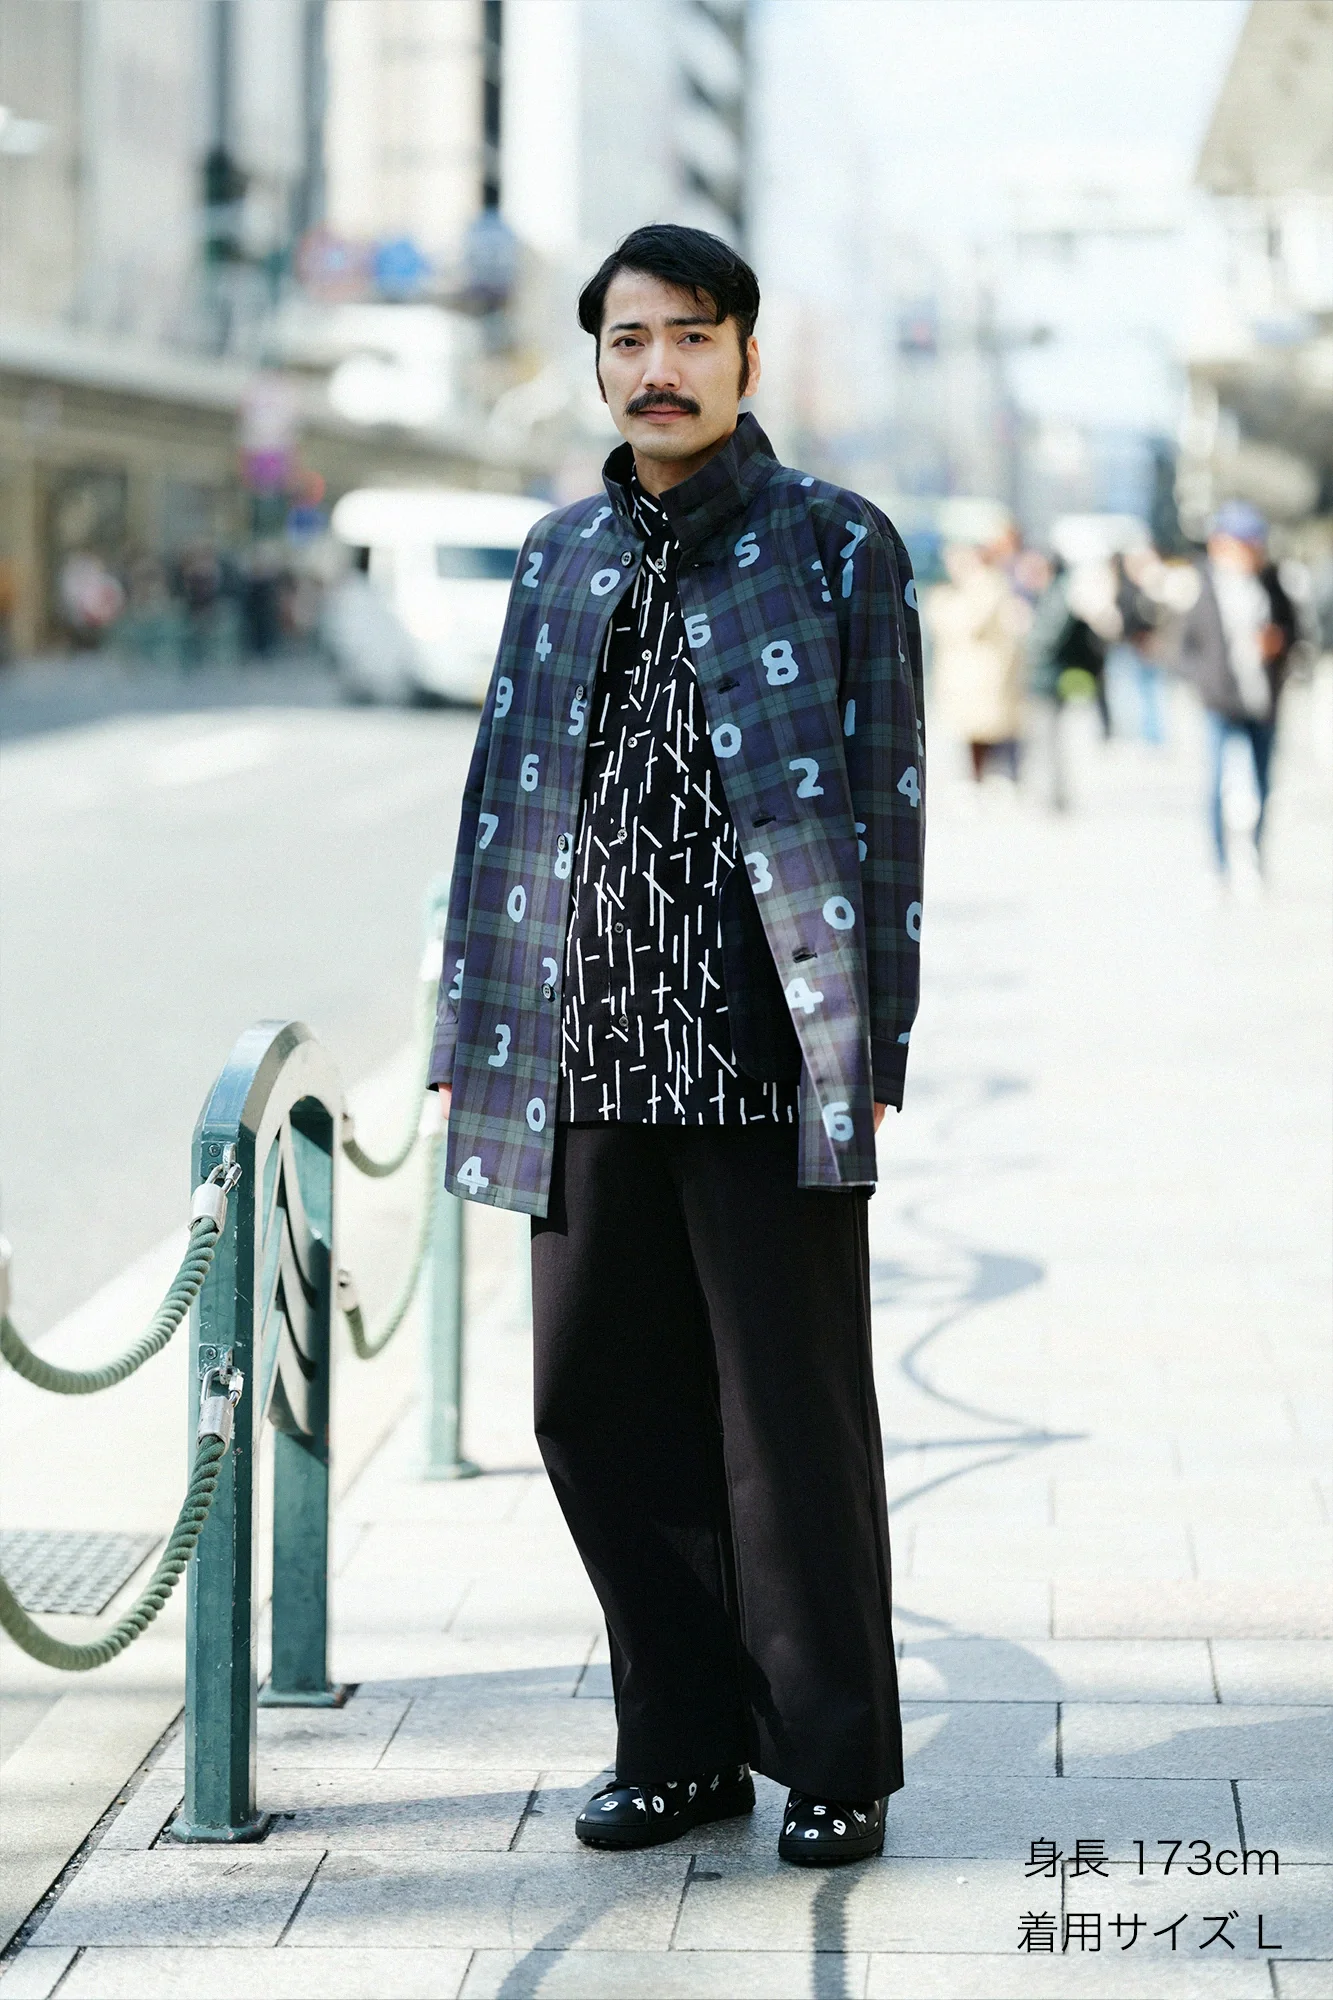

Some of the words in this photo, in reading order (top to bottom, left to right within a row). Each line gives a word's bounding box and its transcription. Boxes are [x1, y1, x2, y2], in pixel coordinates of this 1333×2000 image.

[734, 531, 761, 568] 5
[521, 551, 544, 588] 2
[590, 568, 621, 596] 0
[535, 622, 553, 662] 4
[684, 612, 712, 648] 6
[760, 639, 799, 686] 8
[493, 676, 514, 718] 9
[567, 697, 588, 736] 5
[711, 722, 742, 758] 0
[520, 753, 540, 792] 6
[788, 757, 825, 799] 2
[896, 766, 921, 808] 4
[478, 812, 499, 850] 7
[553, 831, 574, 880] 8
[744, 851, 774, 894] 3
[506, 884, 527, 923] 0
[822, 895, 855, 931] 0
[784, 977, 825, 1015] 4
[487, 1023, 512, 1068] 3
[526, 1096, 547, 1133] 0
[822, 1101, 854, 1142] 6
[456, 1155, 490, 1196] 4
[652, 1795, 665, 1814] 0
[832, 1819, 847, 1836] 9
